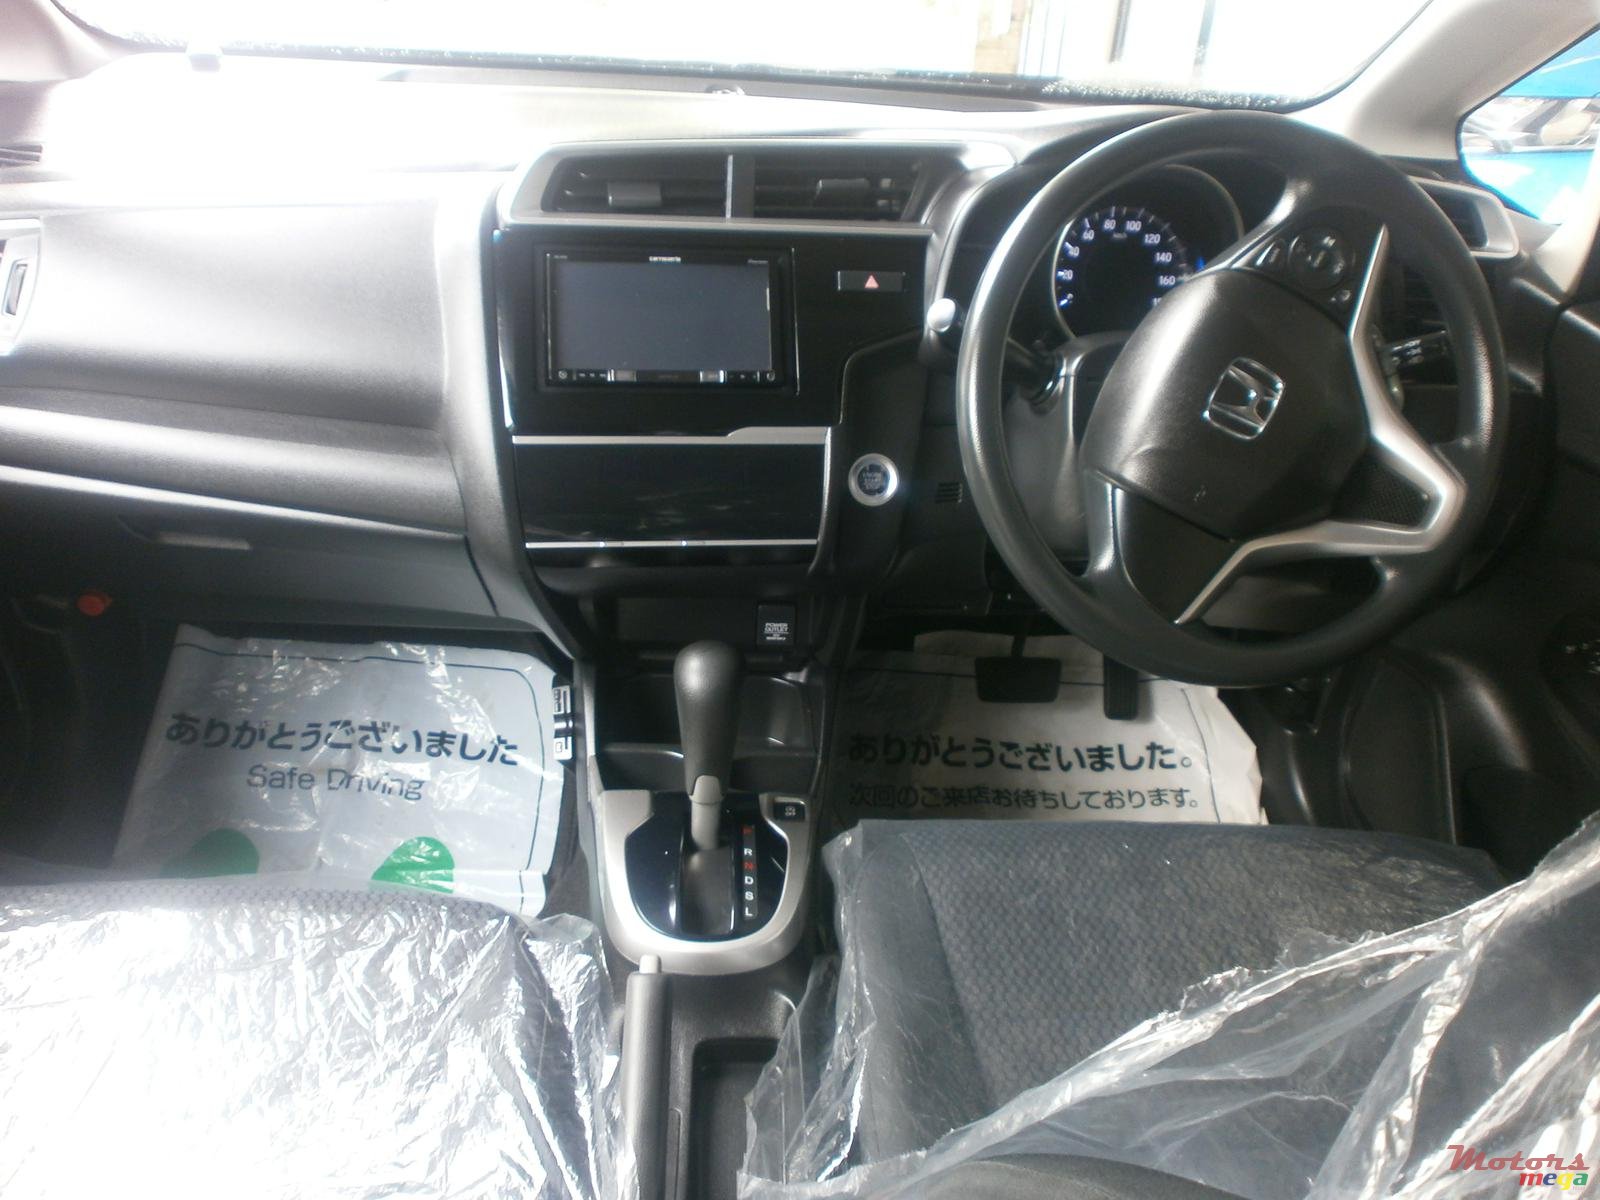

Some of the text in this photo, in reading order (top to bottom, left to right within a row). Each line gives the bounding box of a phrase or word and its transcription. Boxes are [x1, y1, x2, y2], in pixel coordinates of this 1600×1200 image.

[1104, 219, 1116, 230] 80
[1126, 220, 1142, 231] 100
[1083, 231, 1095, 241] 60
[1144, 233, 1161, 243] 120
[1069, 246, 1080, 256] 40
[1156, 252, 1172, 262] 140
[1063, 270, 1073, 280] 20
[1159, 275, 1176, 285] 160
[165, 713, 518, 766] ありがとうございました
[848, 732, 1193, 772] ありがとうございました。
[246, 764, 425, 801] Safe Driving
[849, 783, 1199, 811] 次回のご来店お待ちしております。
[743, 848, 753, 856] R
[744, 876, 754, 885] D
[744, 891, 754, 901] S
[745, 907, 753, 917] L
